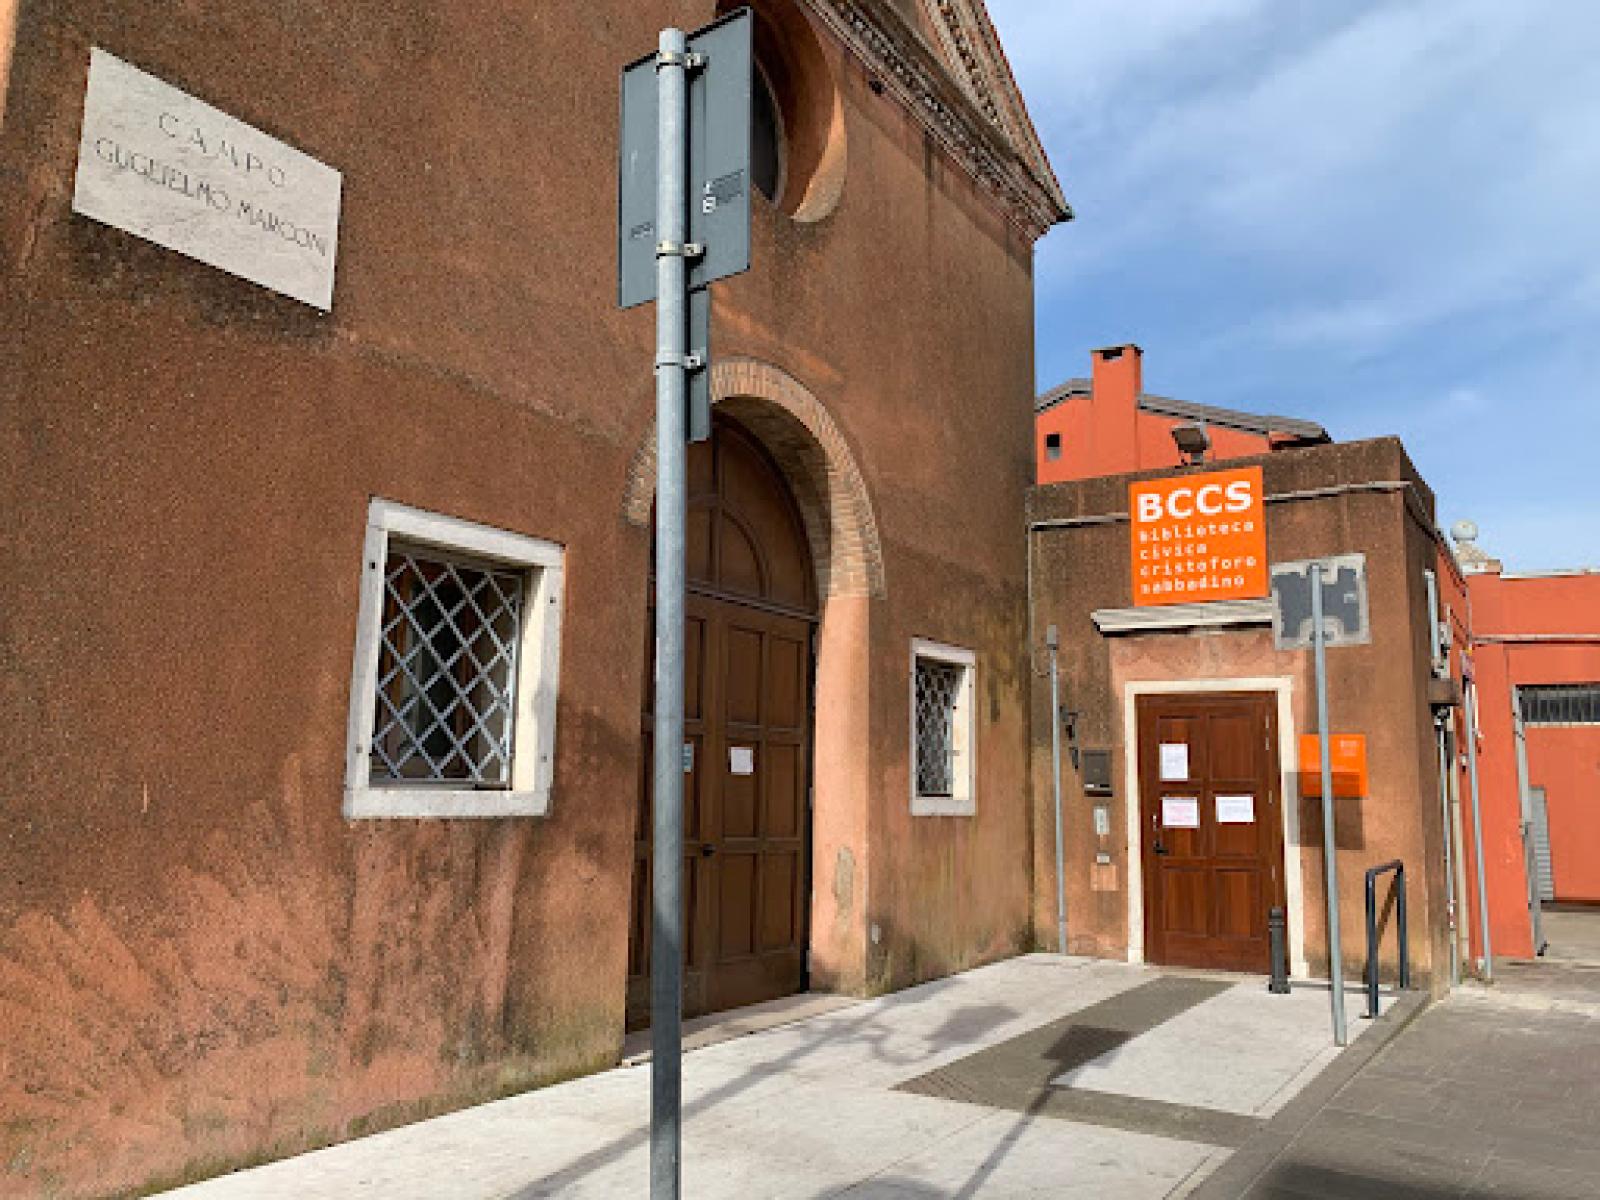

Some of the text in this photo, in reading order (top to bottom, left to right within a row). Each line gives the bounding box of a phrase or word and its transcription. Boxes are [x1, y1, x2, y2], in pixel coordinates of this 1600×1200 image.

[158, 112, 285, 187] CAMPO
[96, 137, 231, 212] GUGLIELMO
[1138, 480, 1253, 522] BCCS
[1139, 521, 1254, 544] biblioteca
[1140, 542, 1207, 560] civica
[1140, 556, 1257, 577] cristoforo
